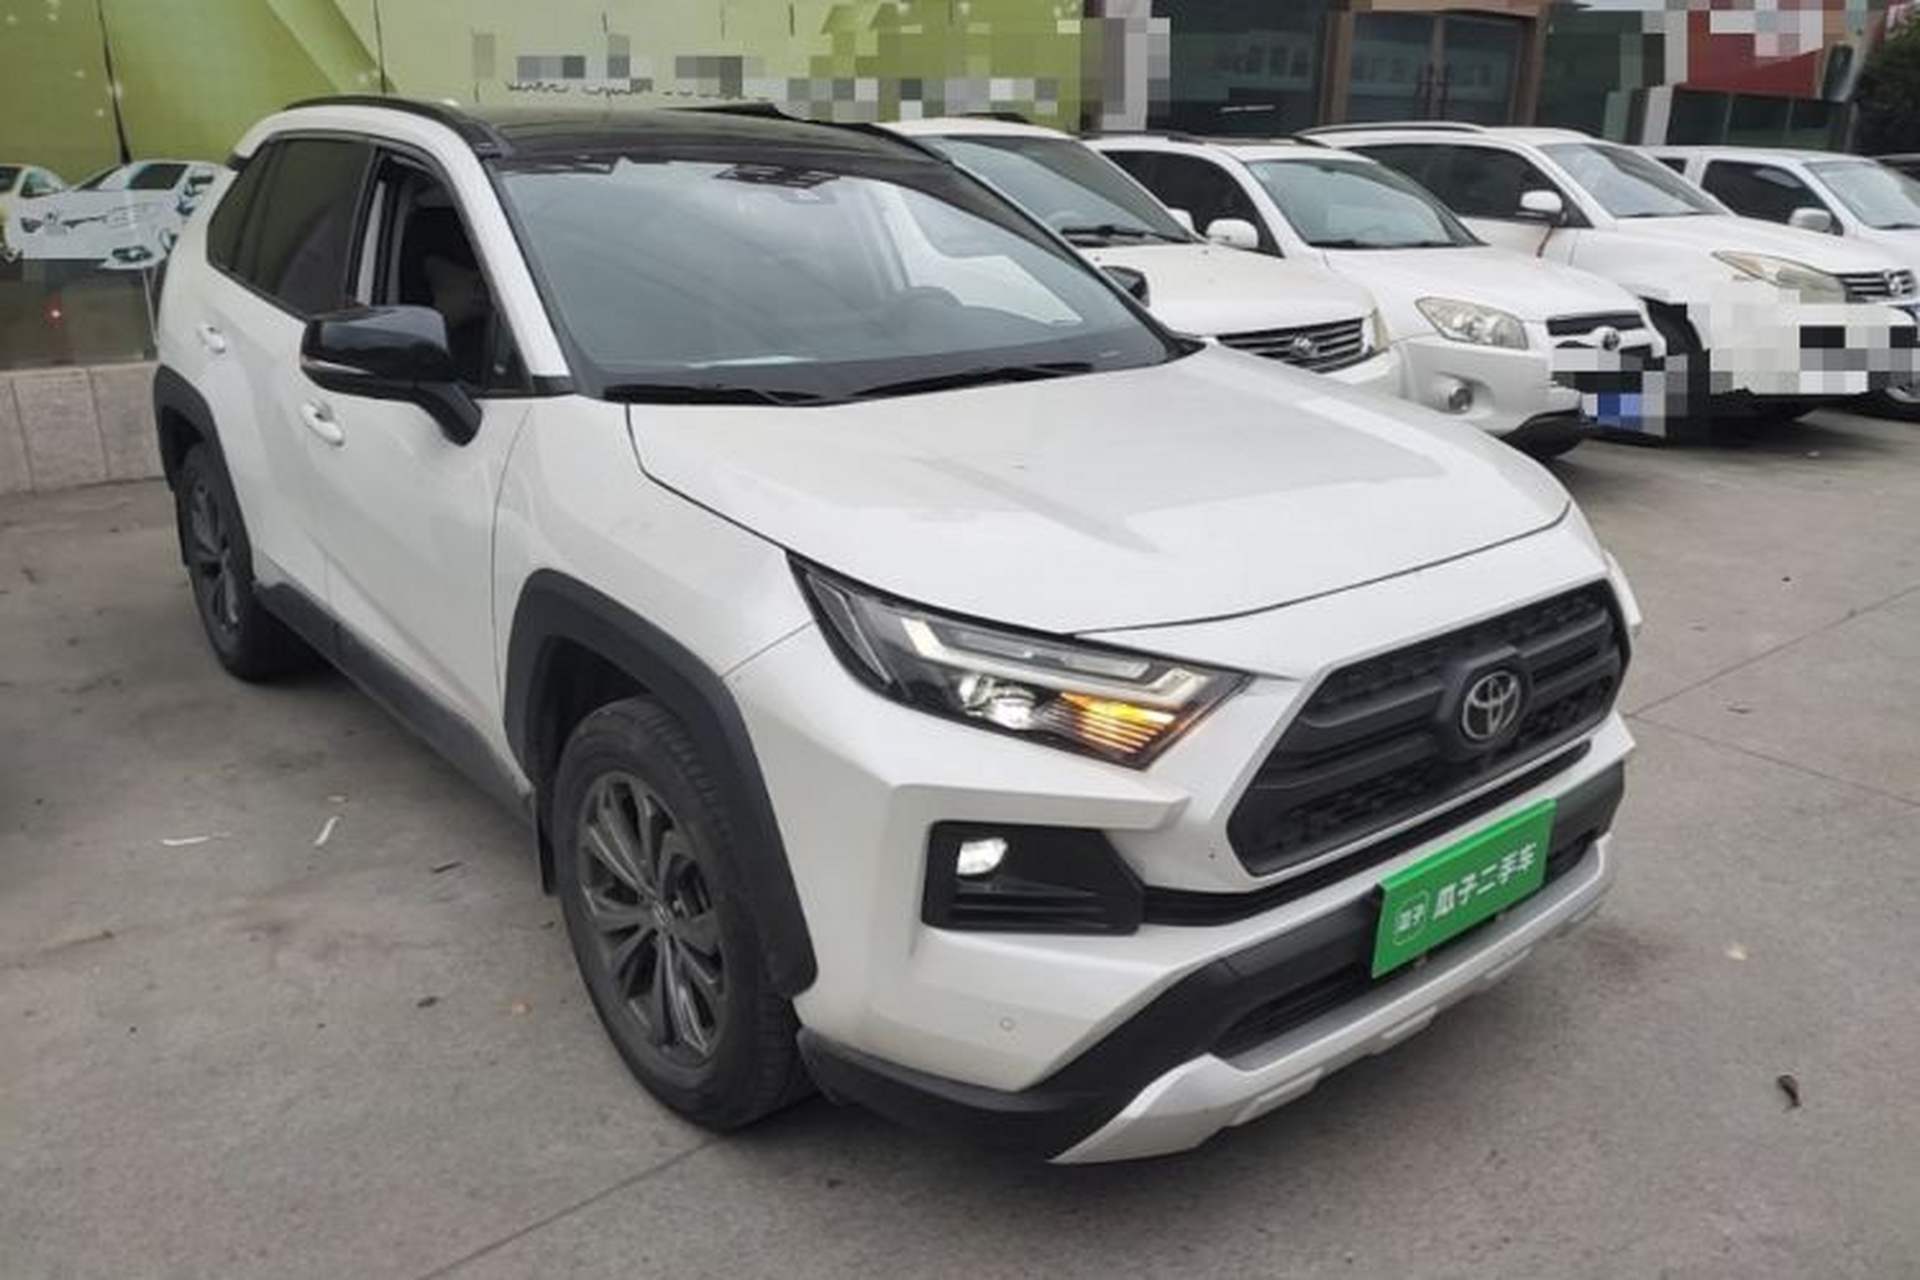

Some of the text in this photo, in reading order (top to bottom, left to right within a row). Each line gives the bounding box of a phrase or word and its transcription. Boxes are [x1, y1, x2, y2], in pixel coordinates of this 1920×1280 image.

[1434, 842, 1537, 920] 瓜子二手车
